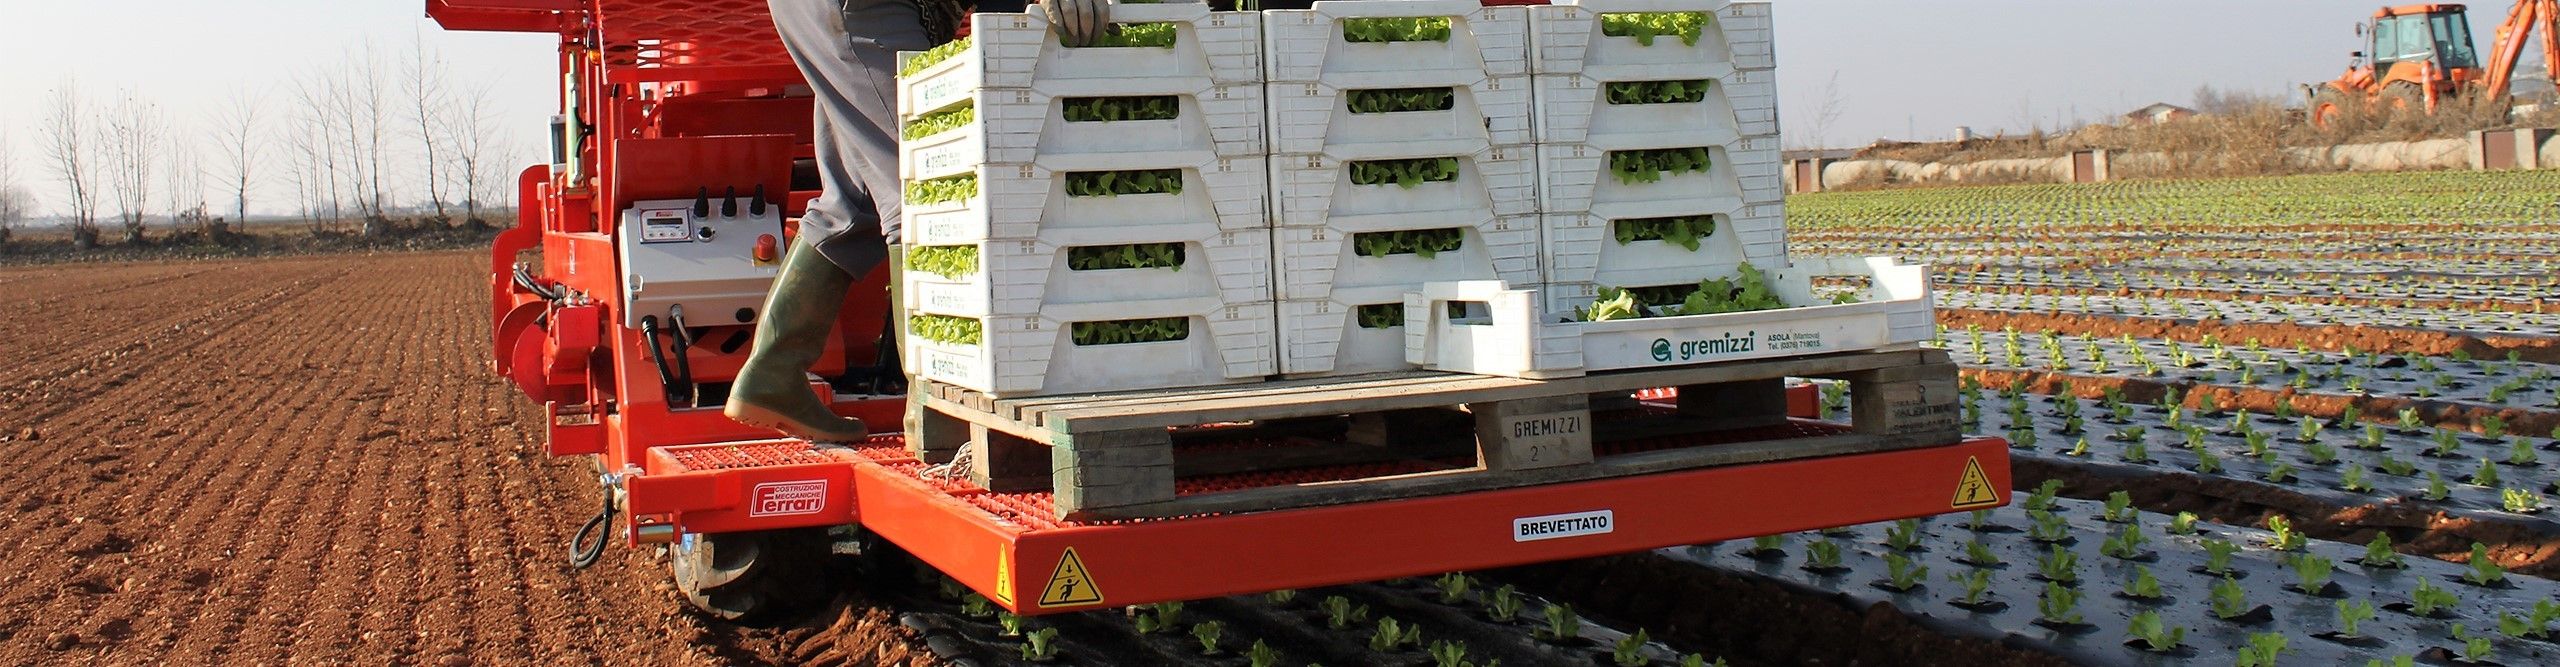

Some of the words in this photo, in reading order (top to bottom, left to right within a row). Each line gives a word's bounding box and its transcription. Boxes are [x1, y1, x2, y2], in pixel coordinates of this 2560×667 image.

[1680, 330, 1755, 361] gremizzi
[1767, 333, 1790, 342] ASOLA
[1514, 416, 1581, 438] GREMIZZI
[774, 484, 822, 493] COSTRUZIONI
[775, 491, 821, 500] MECCANICHE
[755, 487, 820, 512] Ferrari
[1521, 515, 1608, 536] BREVETTATO
